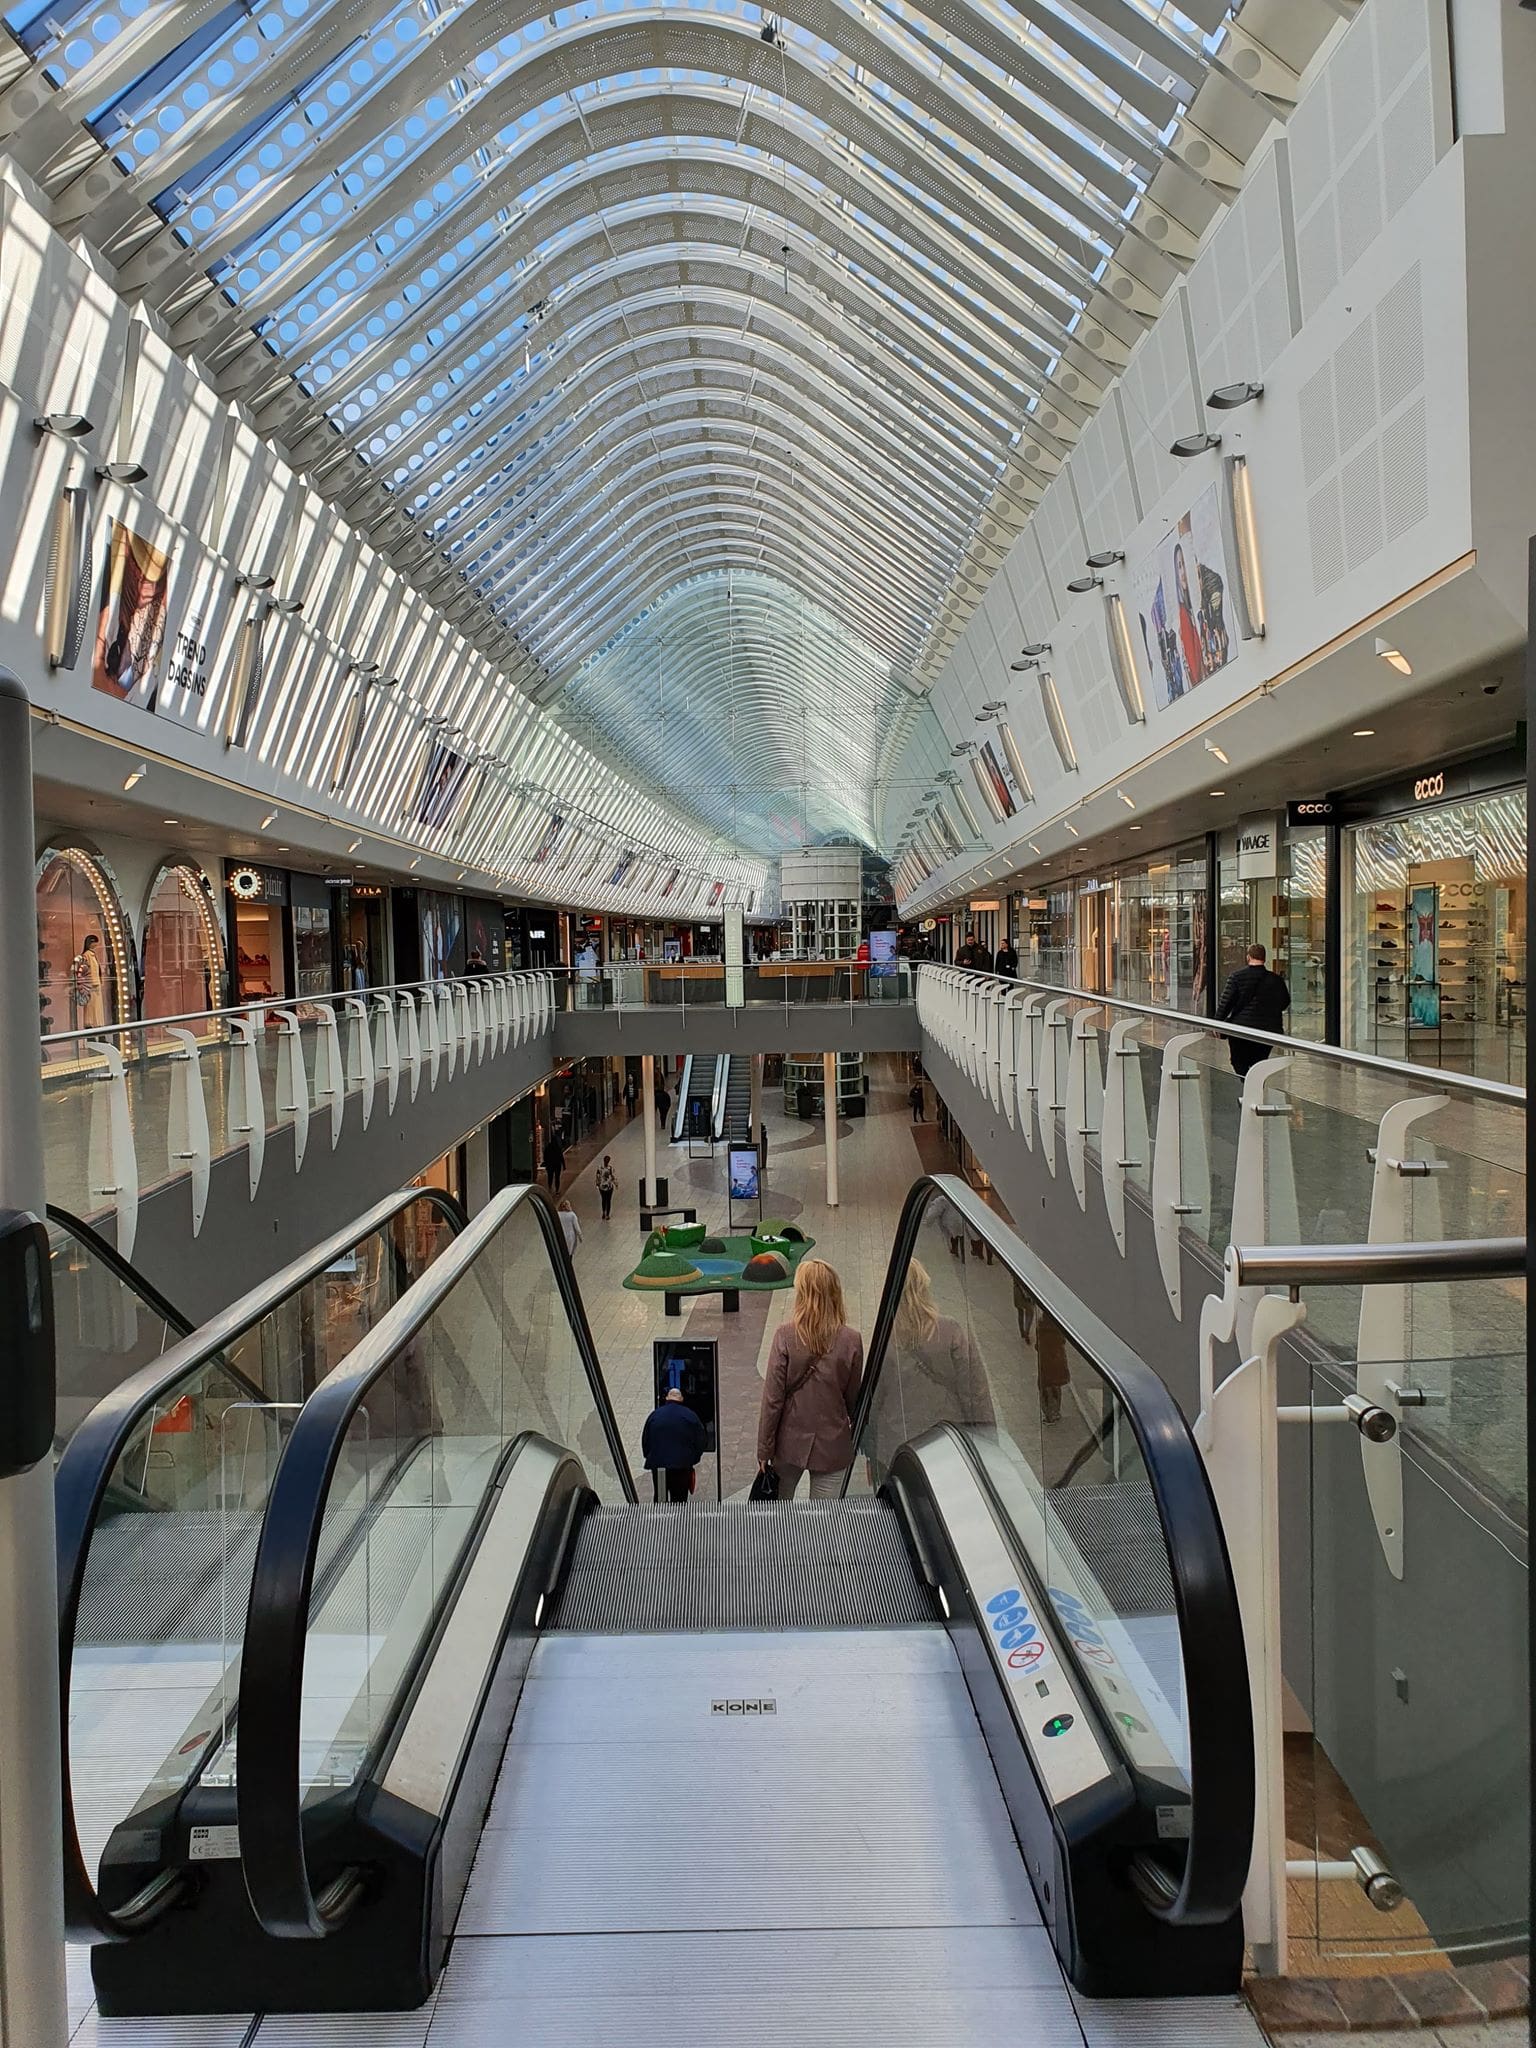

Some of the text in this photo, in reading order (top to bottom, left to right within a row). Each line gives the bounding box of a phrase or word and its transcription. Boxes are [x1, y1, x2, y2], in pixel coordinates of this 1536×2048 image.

[177, 631, 206, 666] TREND
[168, 658, 206, 697] DAGSINS
[1414, 772, 1444, 800] ecco
[1297, 803, 1333, 814] ecco
[712, 1702, 775, 1713] KONE
